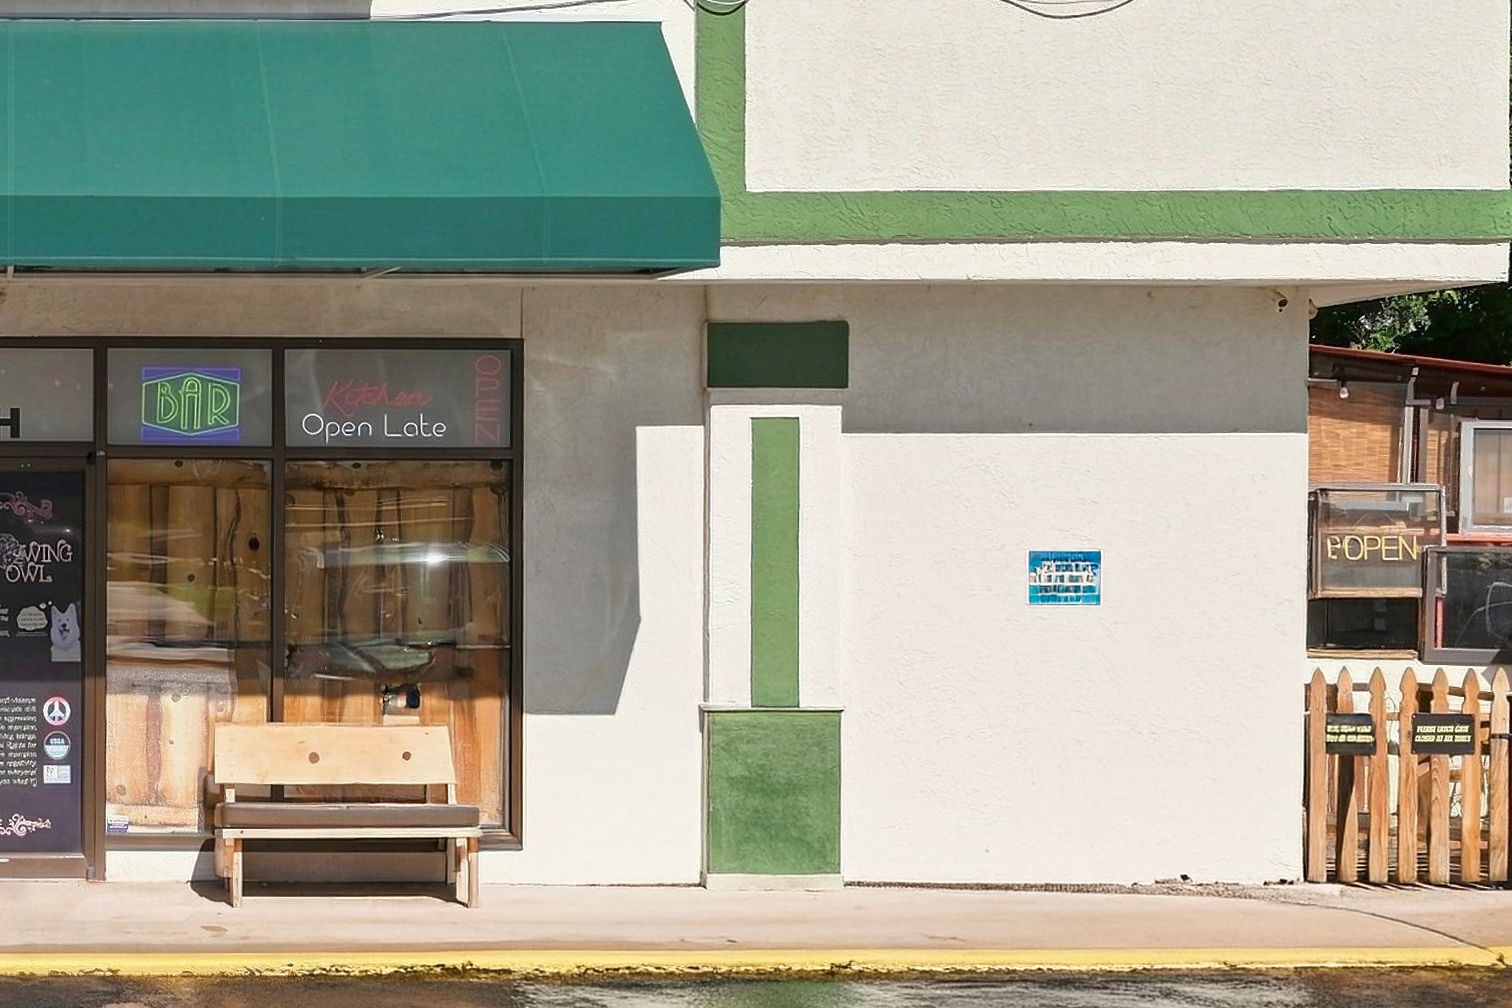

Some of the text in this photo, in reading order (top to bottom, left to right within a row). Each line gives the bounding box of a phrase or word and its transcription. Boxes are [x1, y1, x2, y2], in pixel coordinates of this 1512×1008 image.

[155, 376, 231, 430] BAR
[322, 379, 432, 418] Kitchen
[302, 413, 447, 443] Open Late
[1343, 535, 1418, 561] OPEN
[6, 562, 53, 582] OWL
